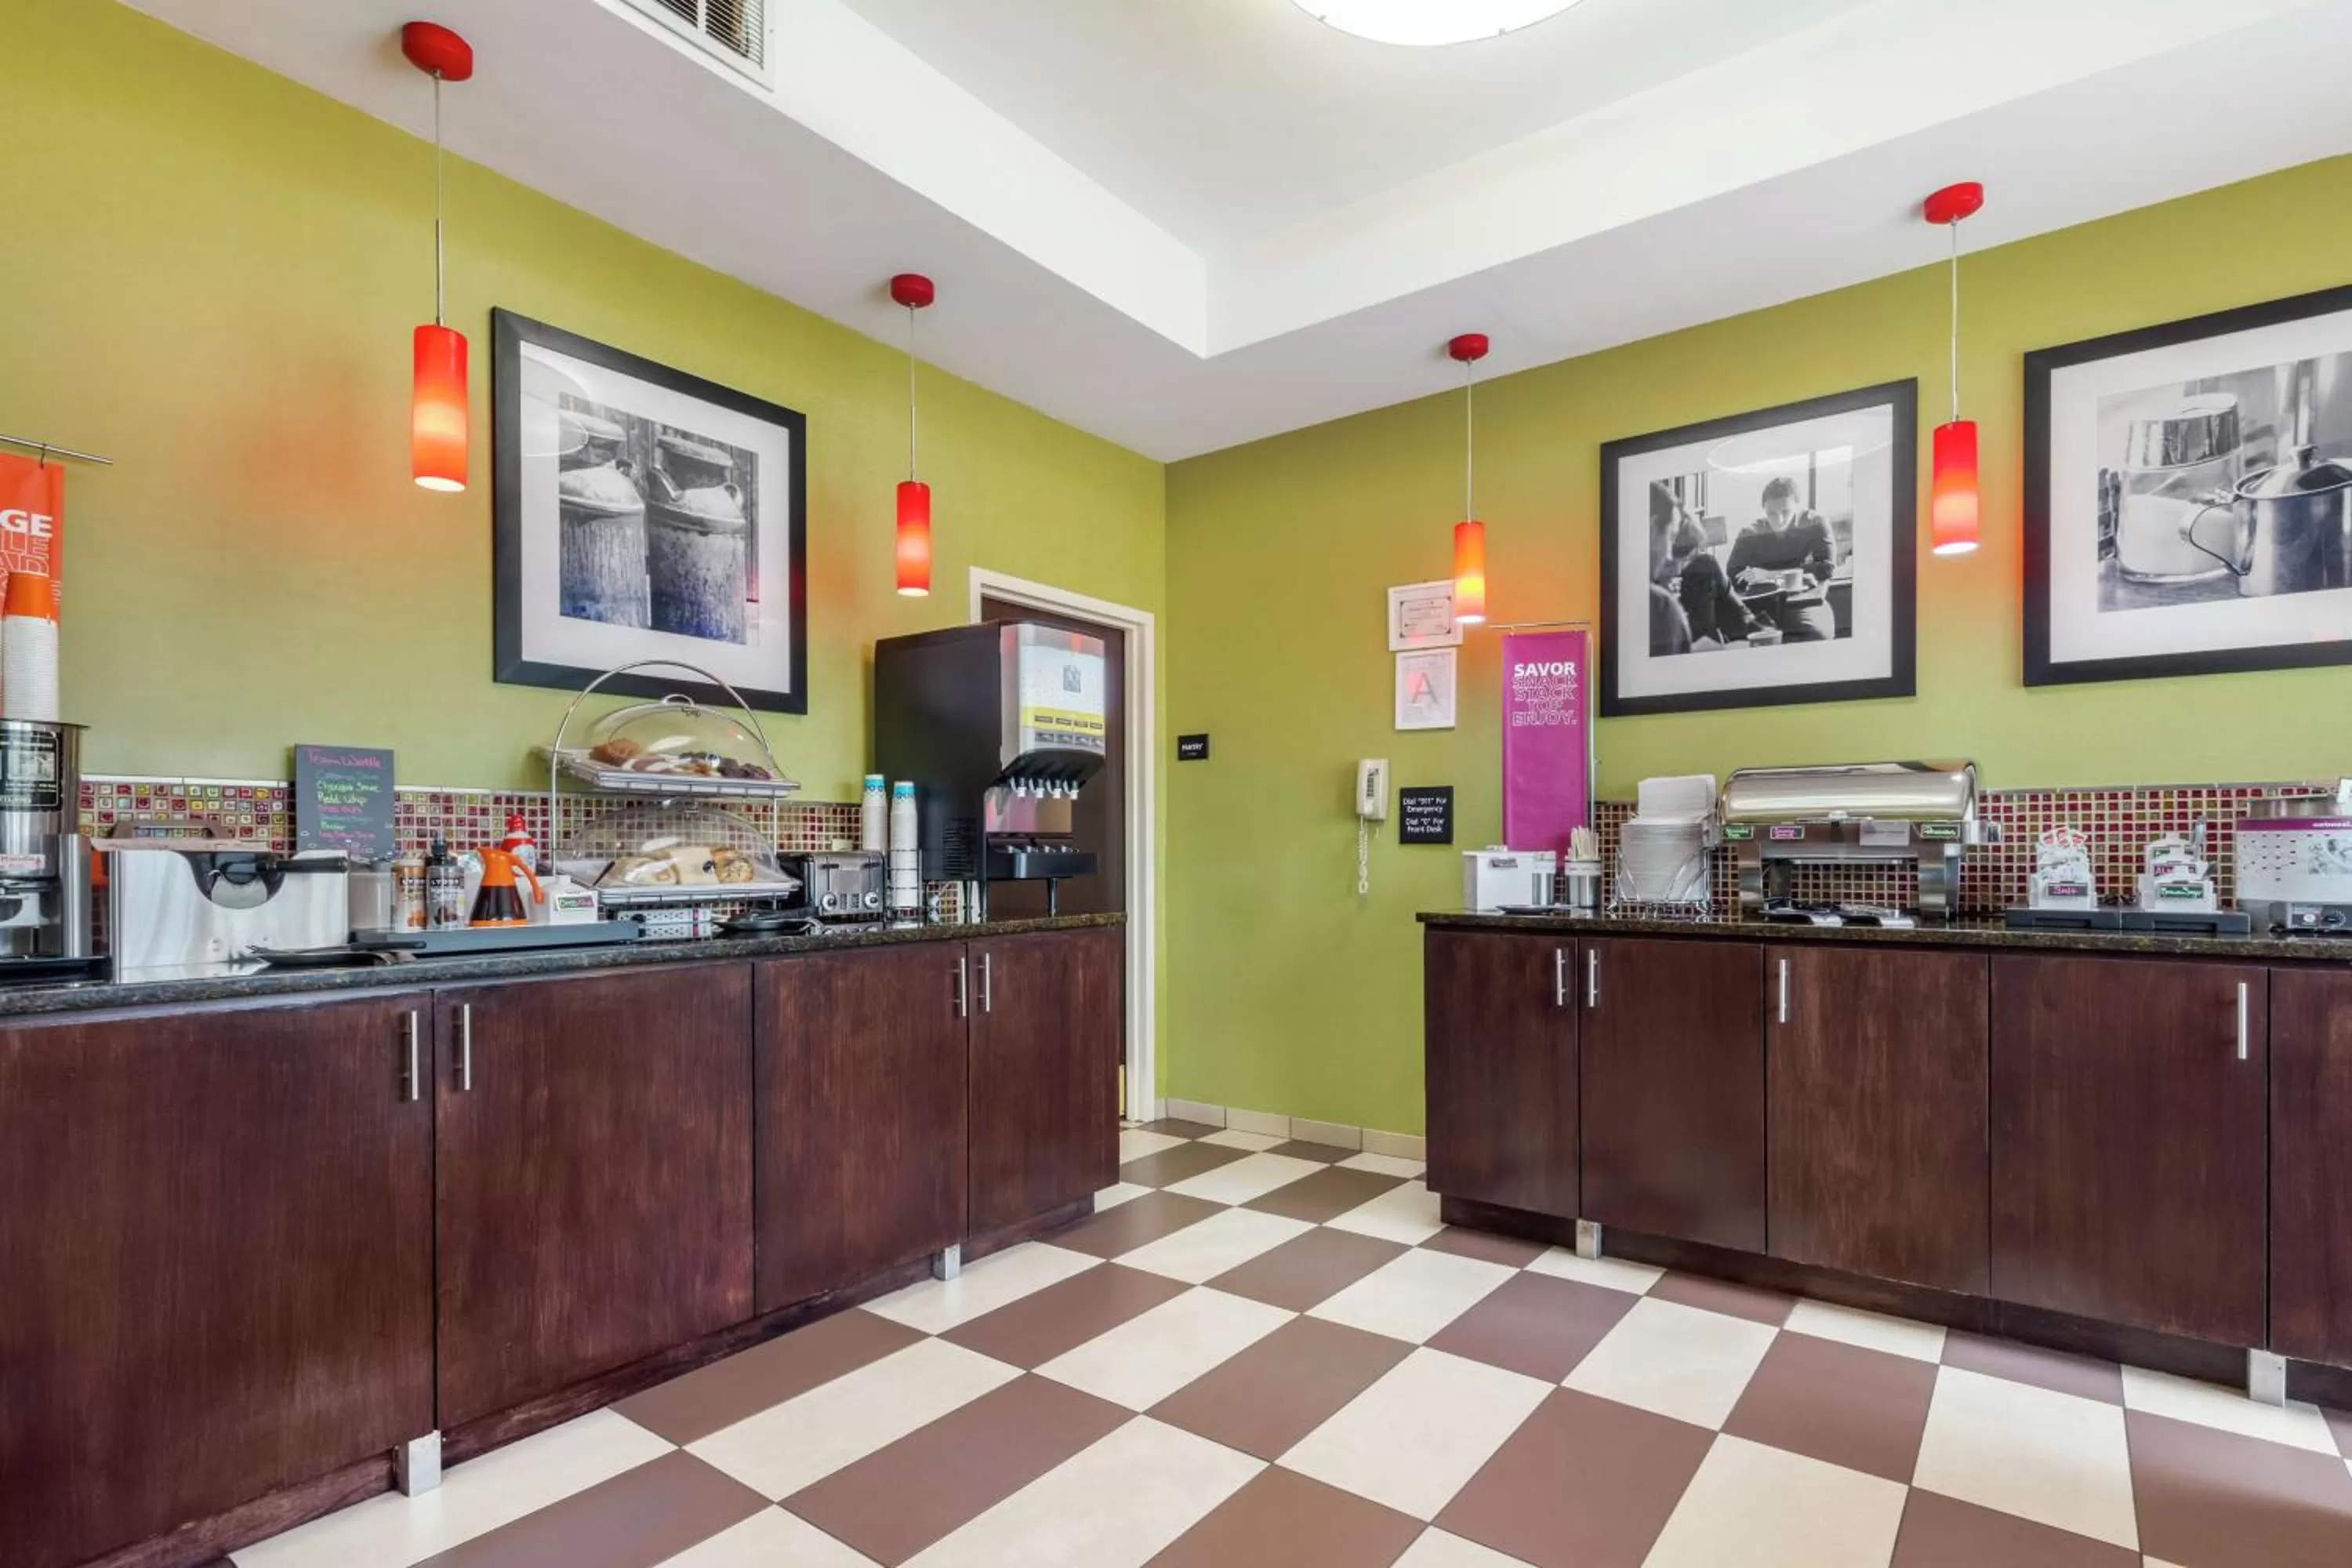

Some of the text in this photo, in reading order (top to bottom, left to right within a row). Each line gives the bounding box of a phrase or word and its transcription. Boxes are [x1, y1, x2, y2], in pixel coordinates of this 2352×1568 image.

[1514, 662, 1575, 677] SAVOR
[1412, 672, 1438, 704] A
[1512, 675, 1578, 689] SNACK
[1514, 687, 1576, 702] STACK
[1512, 710, 1577, 727] ENJOY.
